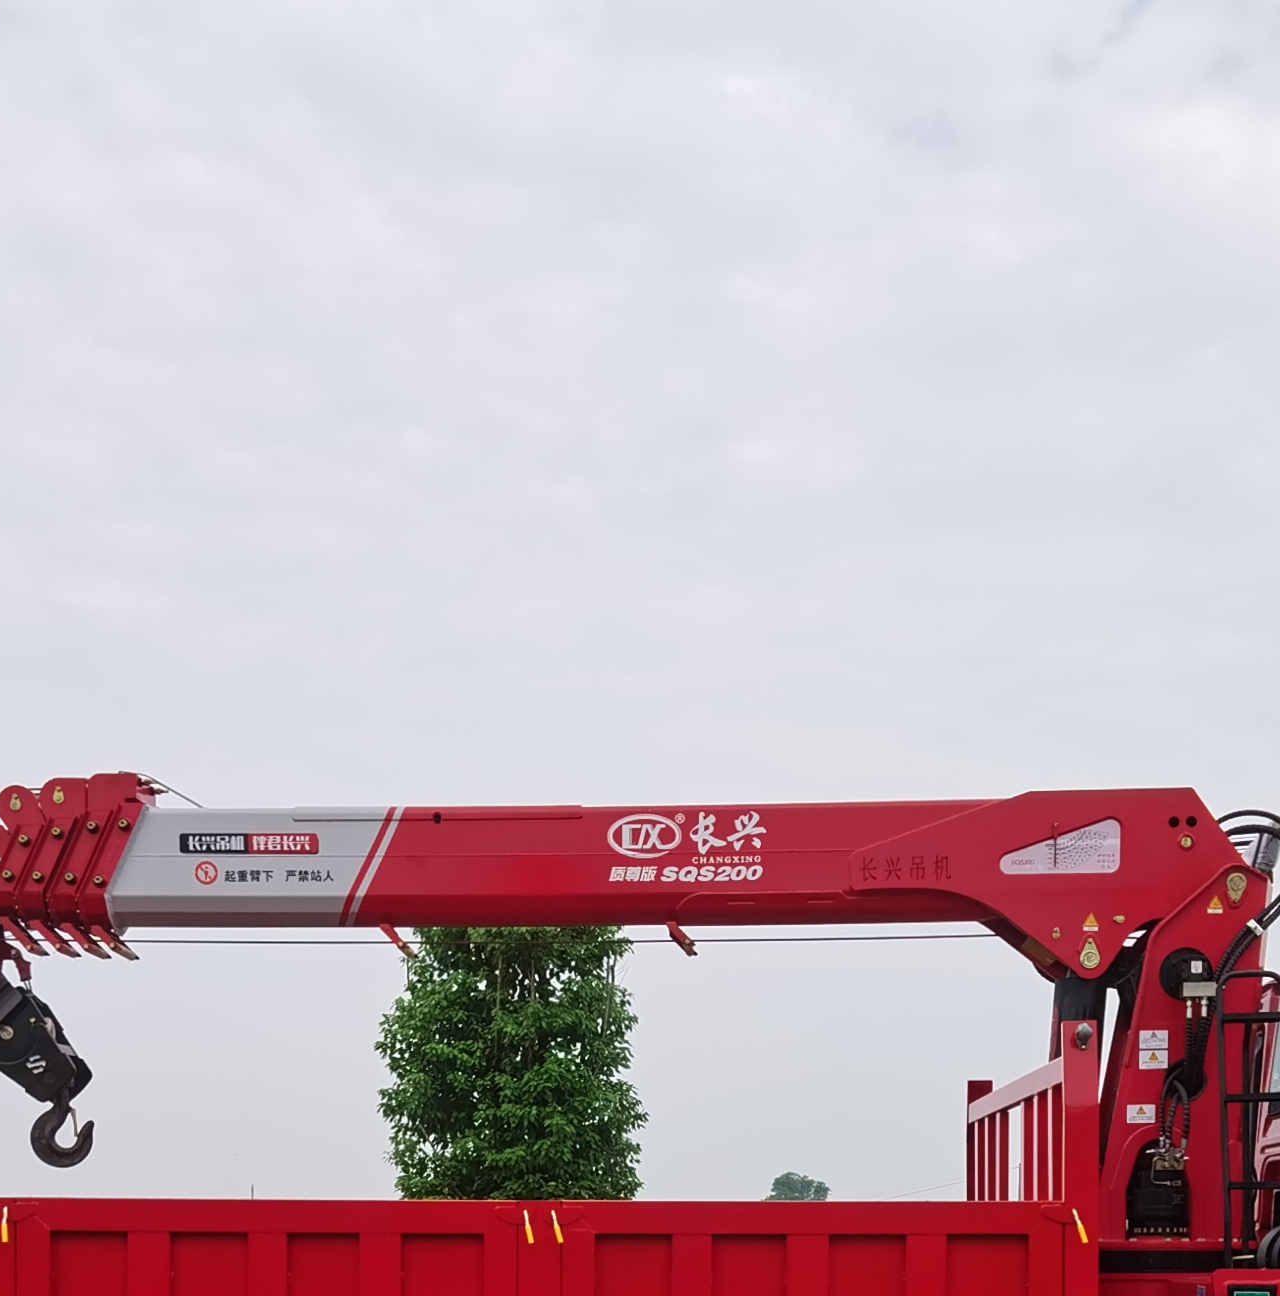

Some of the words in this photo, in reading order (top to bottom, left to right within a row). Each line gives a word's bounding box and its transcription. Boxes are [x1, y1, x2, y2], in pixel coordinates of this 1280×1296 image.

[689, 811, 767, 855] 长兴
[187, 835, 245, 851] 长兴吊机
[691, 855, 762, 864] CHANGXING
[224, 869, 274, 883] 起重臂下
[285, 869, 334, 883] 严禁站人
[660, 865, 763, 882] SQS200
[859, 854, 952, 882] 长兴吊机
